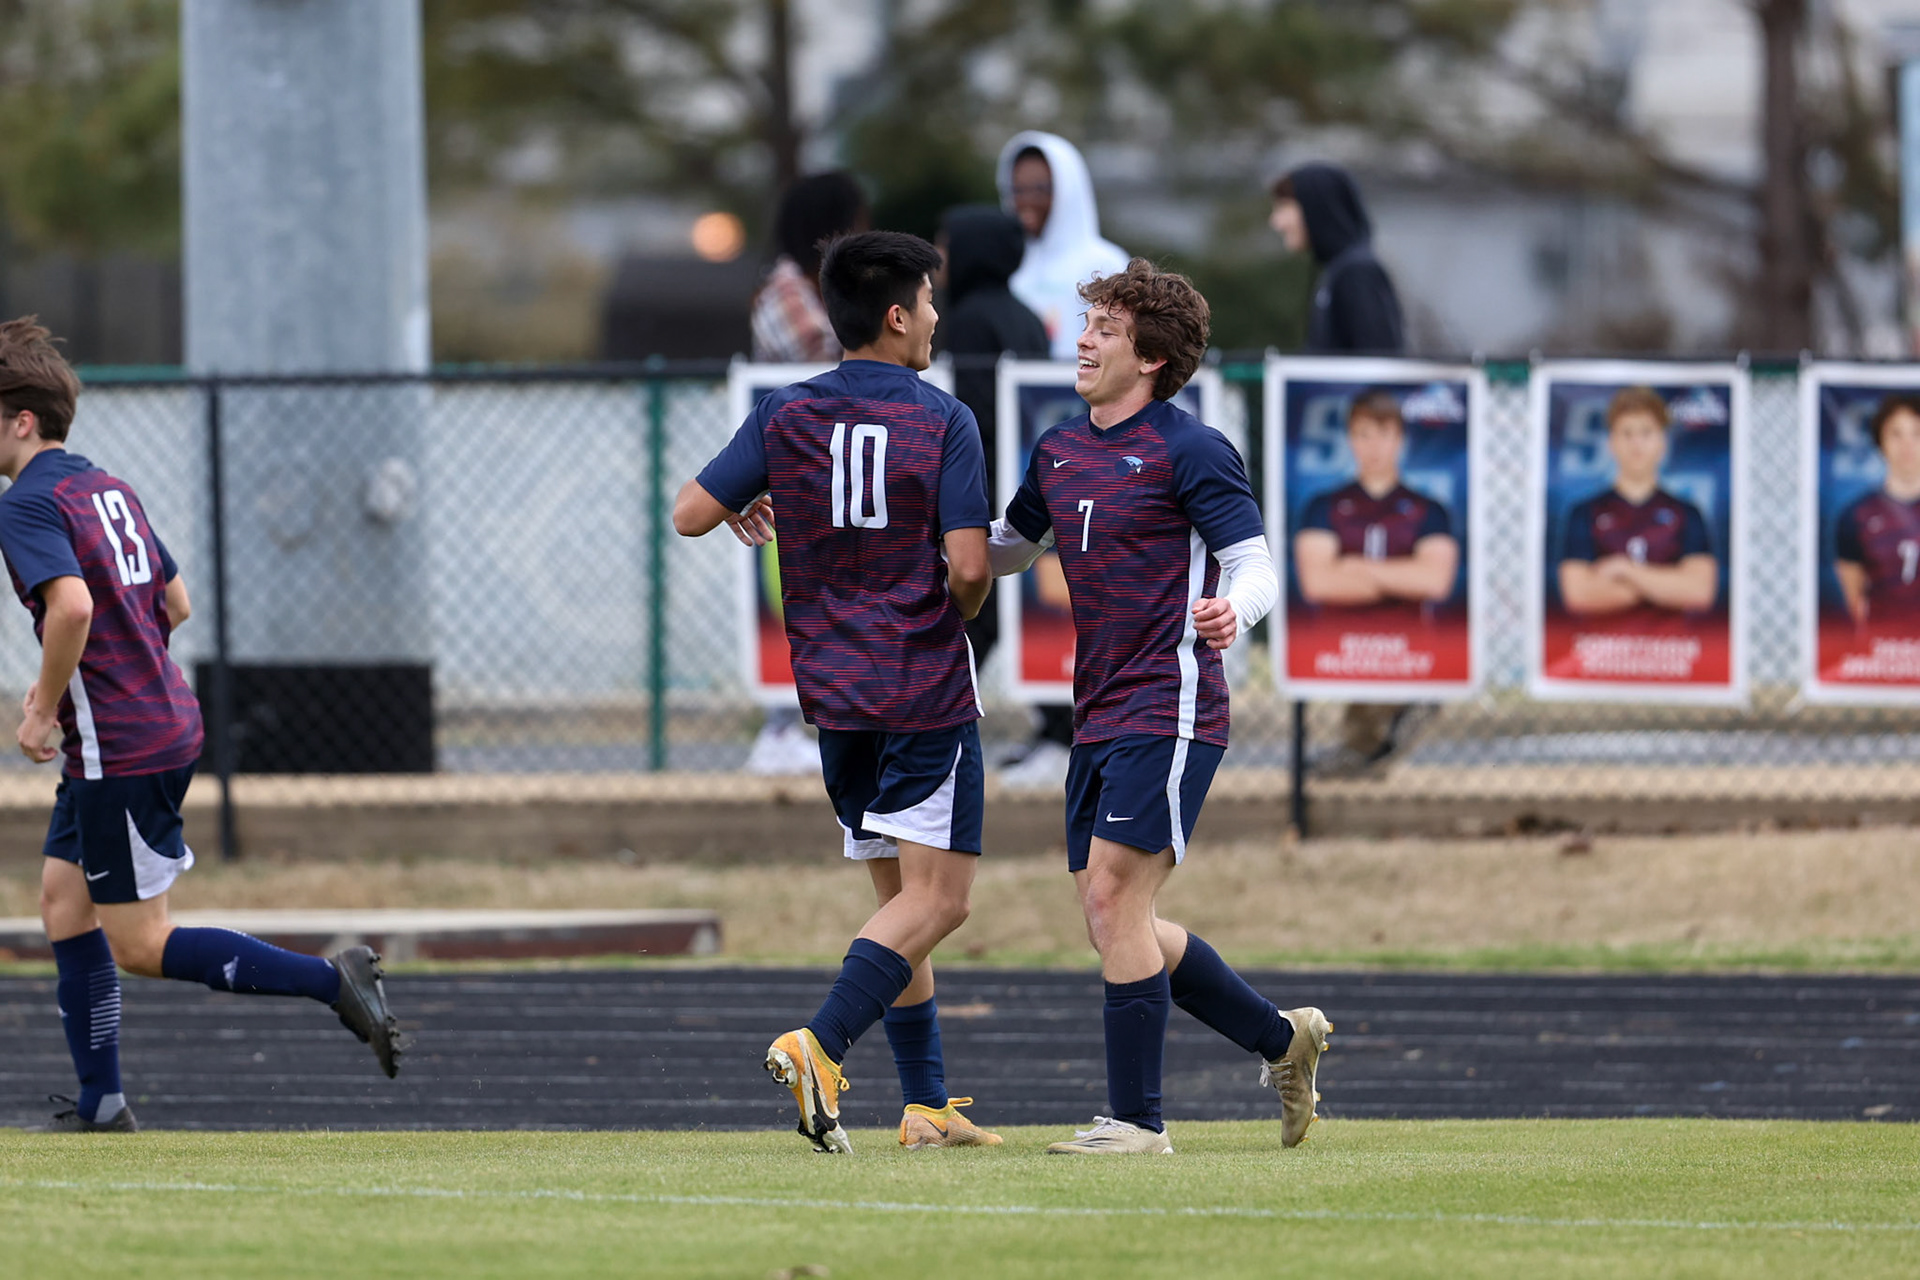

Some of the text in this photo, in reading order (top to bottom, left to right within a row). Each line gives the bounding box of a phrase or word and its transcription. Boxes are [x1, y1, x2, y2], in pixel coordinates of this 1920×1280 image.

[829, 422, 888, 529] 10
[92, 489, 152, 586] 13
[1077, 499, 1094, 552] 7
